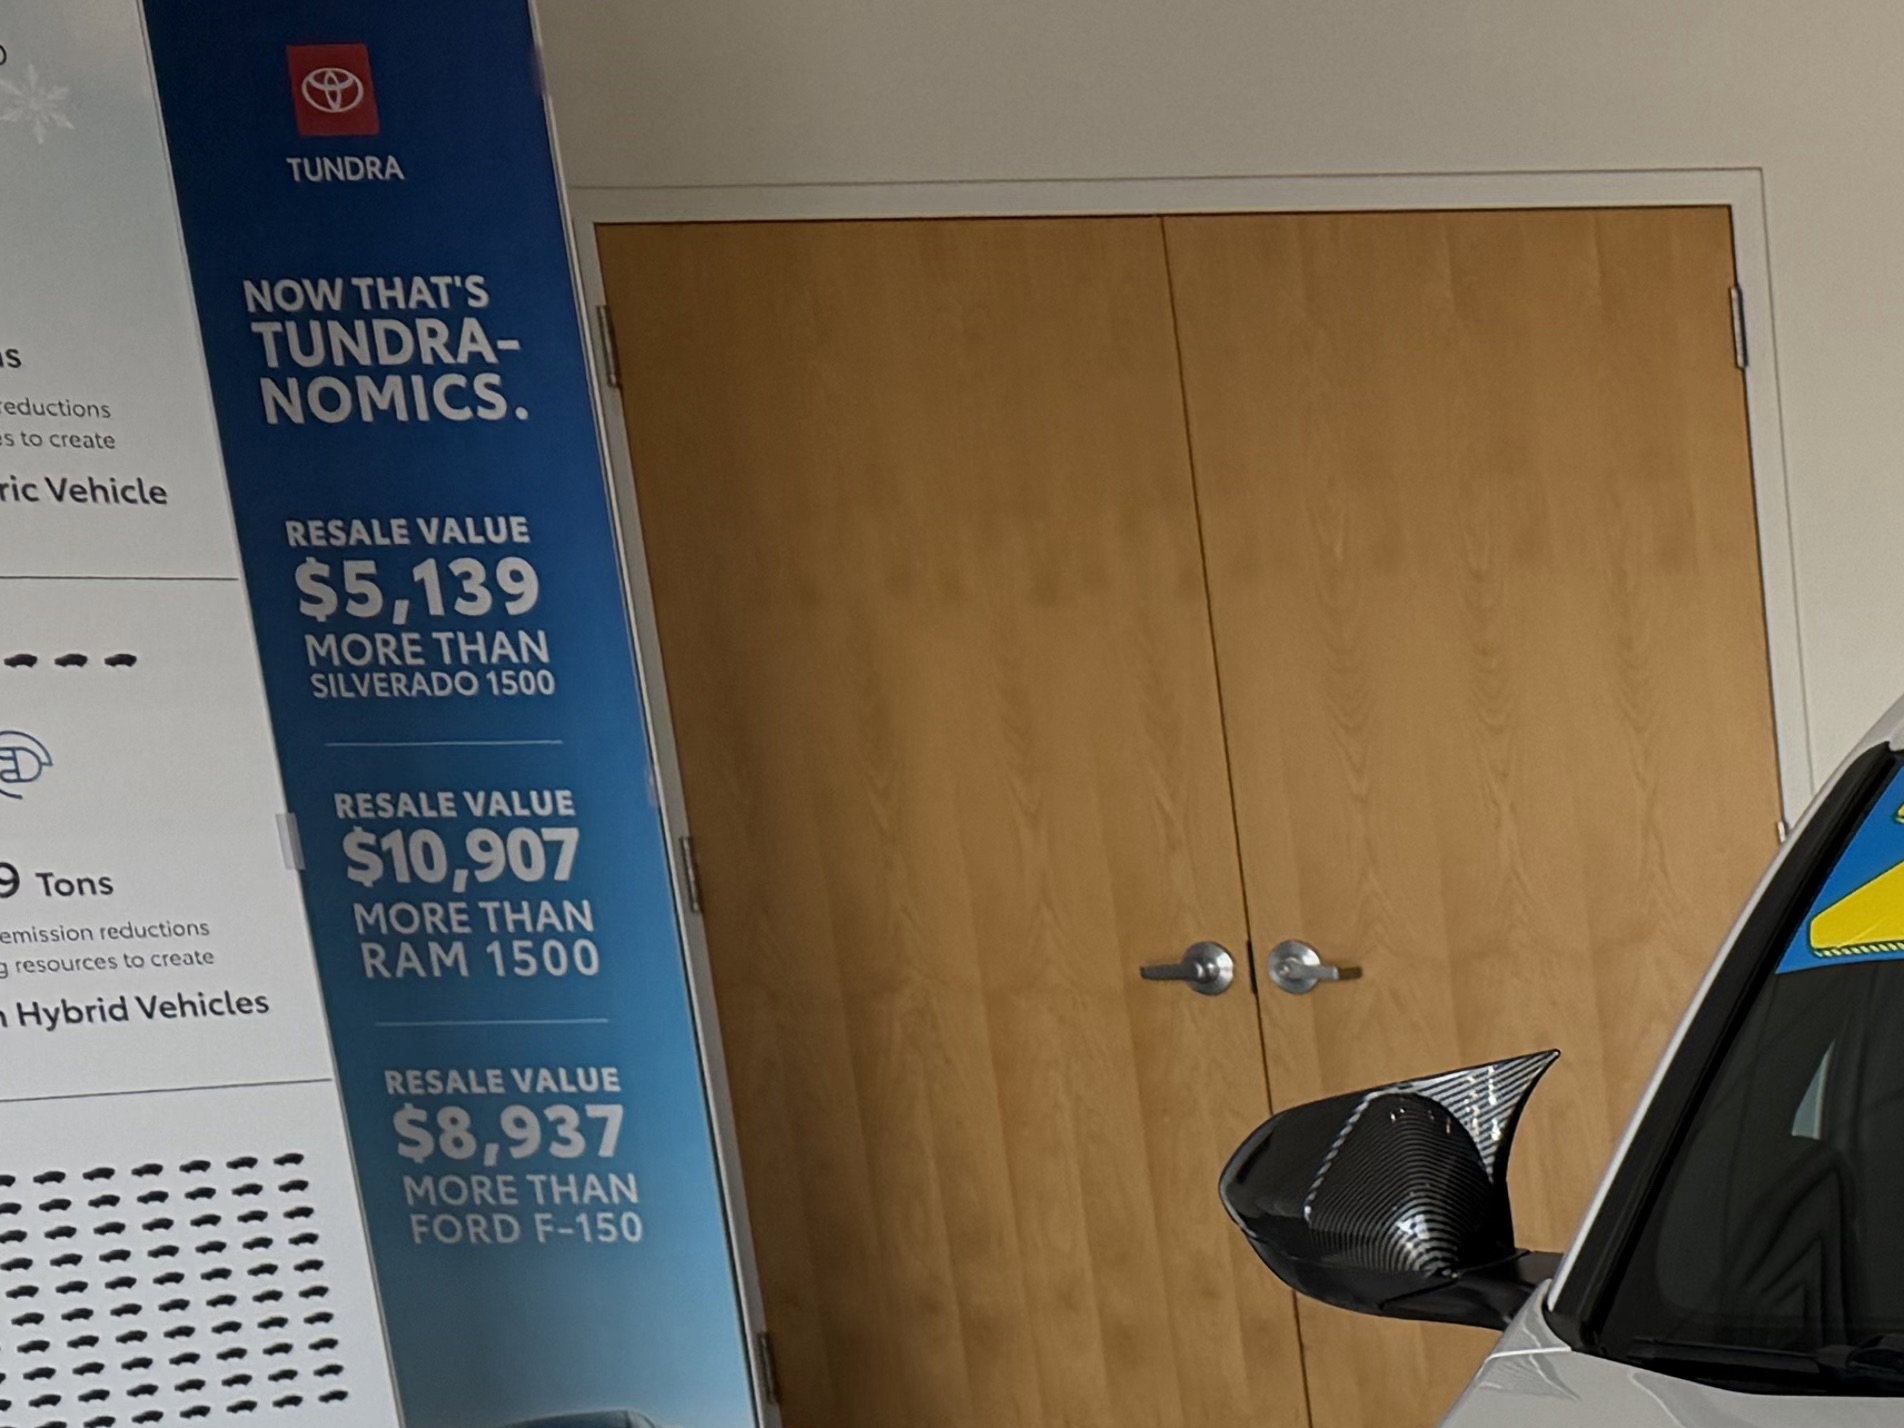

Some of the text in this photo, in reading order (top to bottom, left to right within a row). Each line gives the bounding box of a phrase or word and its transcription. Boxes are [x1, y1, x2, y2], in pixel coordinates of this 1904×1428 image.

[286, 155, 405, 182] TUNDRA
[243, 275, 490, 313] NOW THAT'S
[250, 317, 521, 368] TUNDRA-
[259, 372, 529, 425] NOMICS.
[20, 431, 42, 448] to
[49, 432, 115, 449] create
[45, 476, 167, 504] Vehicle
[285, 516, 531, 547] RESALE VALUE
[295, 556, 540, 625] $5,139
[304, 629, 550, 667] MORE THAN
[310, 669, 556, 698] SILVERADO 1500
[333, 789, 576, 819] RESALE VALUE
[342, 825, 580, 893] $10,907
[35, 872, 114, 897] Tons
[100, 920, 210, 941] reductions
[353, 899, 595, 935] MORE THAN
[16, 955, 118, 973] resources
[124, 953, 144, 969] to
[151, 950, 215, 968] create
[360, 938, 600, 979] RAM 1500
[16, 994, 129, 1031] Hybrid
[134, 990, 270, 1019] Vehicles
[383, 1066, 621, 1095] RESALE VALUE
[392, 1102, 624, 1167] $8,937
[402, 1172, 640, 1205] MORE THAN
[410, 1211, 643, 1244] FORD F-150
